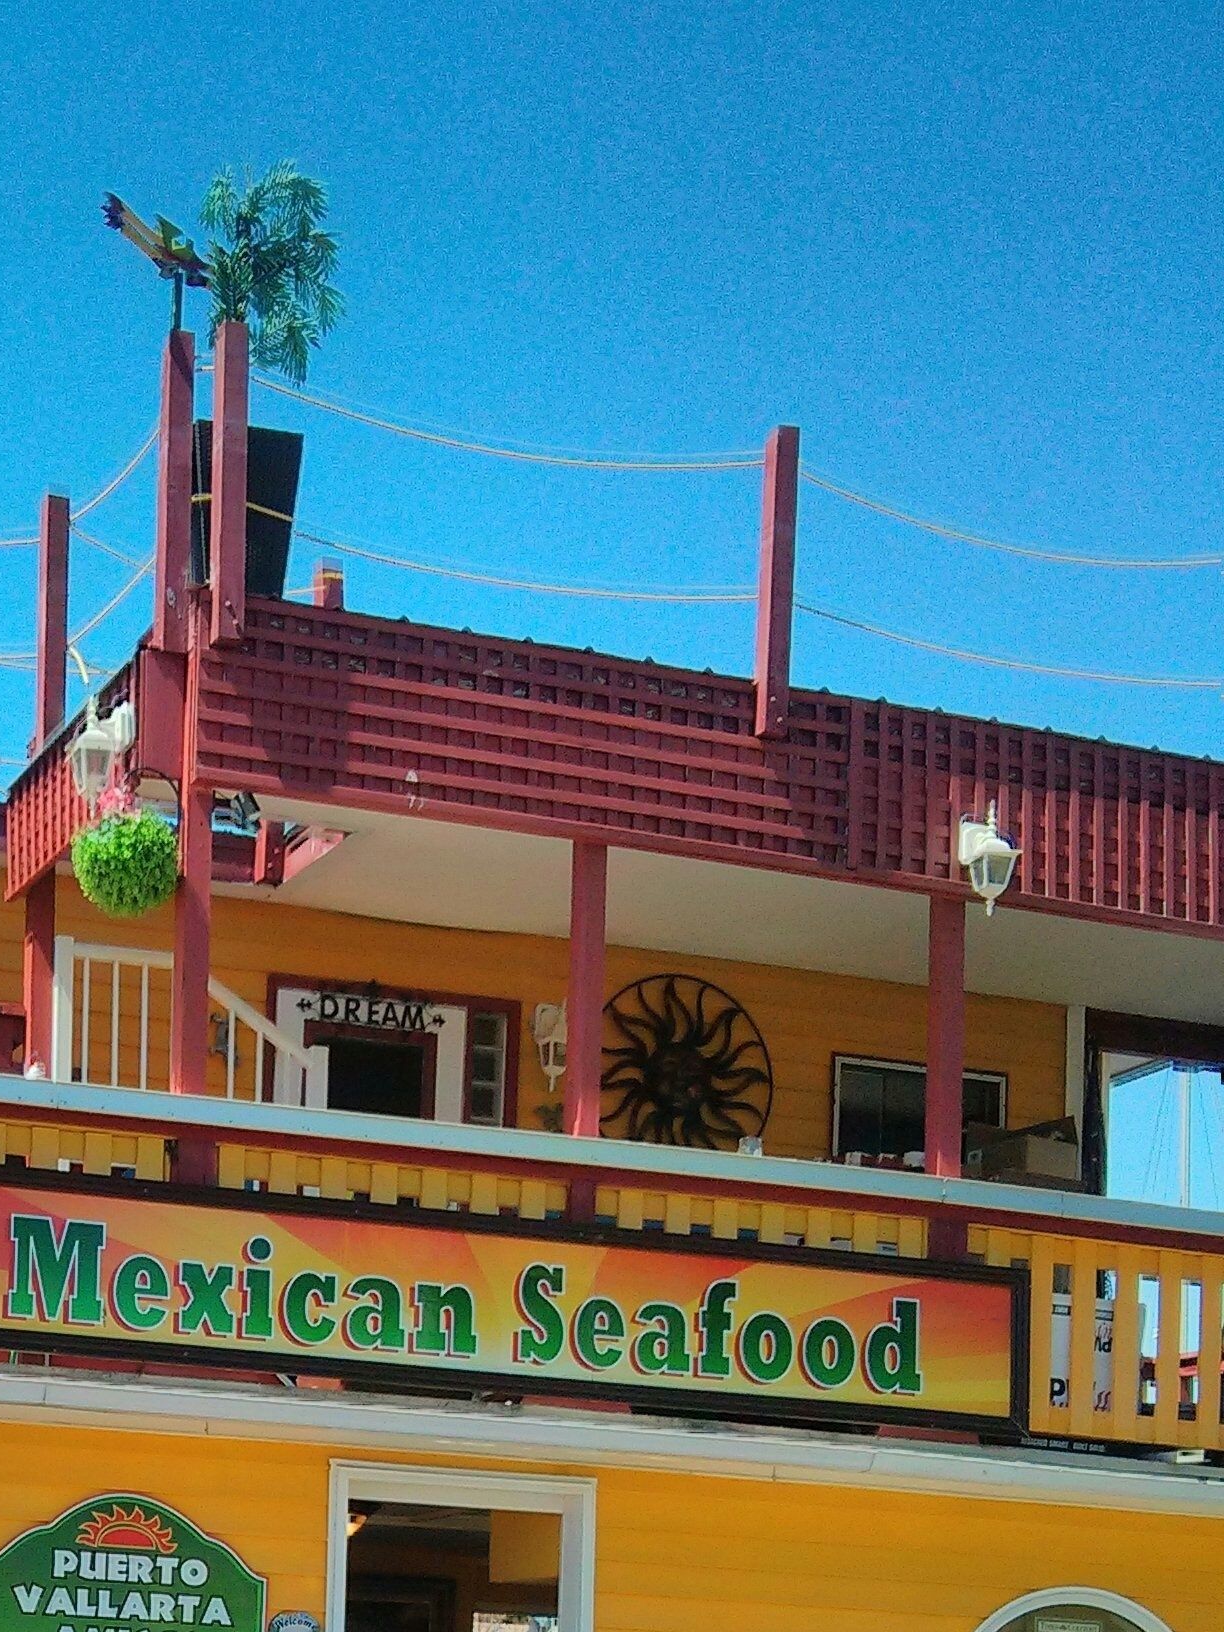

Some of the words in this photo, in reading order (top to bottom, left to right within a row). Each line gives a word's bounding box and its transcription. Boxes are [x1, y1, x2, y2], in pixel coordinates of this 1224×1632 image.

[320, 994, 426, 1030] DREAM
[3, 1212, 479, 1358] Mexican
[512, 1263, 922, 1396] Seafood
[51, 1550, 209, 1587] PUERTO
[13, 1584, 232, 1626] VALLARTA
